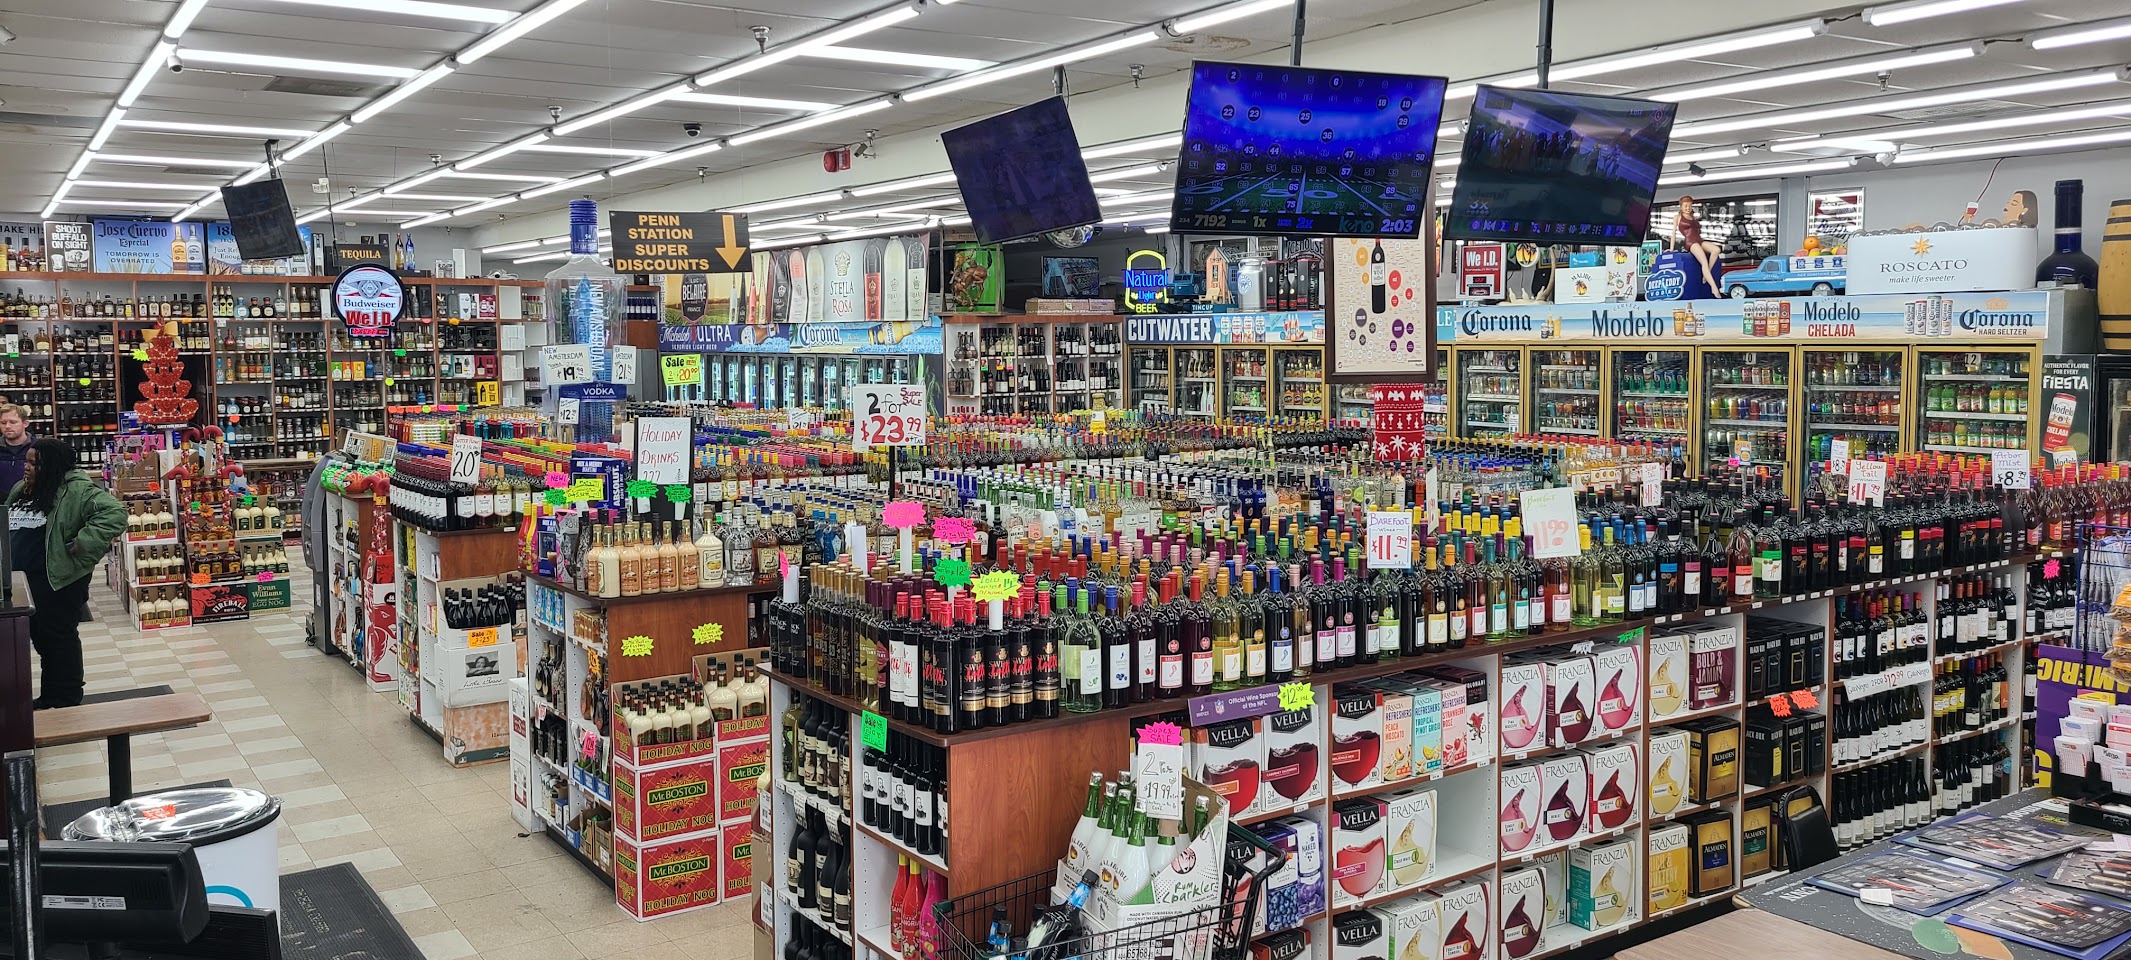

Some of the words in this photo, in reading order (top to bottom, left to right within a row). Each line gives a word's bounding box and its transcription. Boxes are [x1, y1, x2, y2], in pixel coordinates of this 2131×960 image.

[1223, 108, 1233, 116] 22
[1249, 110, 1259, 118] 23
[1300, 112, 1310, 120] 25
[1270, 147, 1279, 155] 44
[1344, 150, 1353, 158] 47
[1215, 162, 1226, 170] 52
[1341, 168, 1351, 176] 57
[1289, 183, 1299, 191] 65
[1286, 200, 1296, 208] 75
[638, 214, 680, 226] PENN
[1194, 215, 1227, 227] 7192
[1253, 216, 1267, 227] 1x
[1296, 217, 1313, 228] 2x
[1339, 216, 1374, 233] keno
[1381, 219, 1414, 233] 2:03
[55, 225, 82, 233] SHOOT
[98, 222, 126, 238] Jose
[127, 224, 168, 238] Cuervo
[628, 228, 693, 240] STATION
[51, 233, 87, 242] BUFFALO
[119, 238, 150, 247] Especial
[51, 241, 63, 249] ON
[64, 241, 89, 250] SIGHT
[635, 244, 688, 256] SUPER
[340, 250, 381, 259] TEQUILA
[1466, 251, 1481, 266] We
[1483, 251, 1498, 266] I.D.
[616, 258, 710, 271] DISCOUNTS
[1880, 259, 1968, 273] ROSCATO
[1125, 270, 1168, 288] Natural
[1571, 272, 1593, 282] MALIBU
[1666, 277, 1680, 287] EDDY
[1889, 276, 1909, 284] make
[1911, 274, 1923, 284] life
[1924, 274, 1956, 282] sweeter.
[682, 283, 707, 300] BELAIRE
[829, 280, 854, 295] STELLA
[1138, 290, 1156, 302] Light
[344, 299, 396, 308] Budweiser
[832, 299, 853, 315] ROSA
[1136, 303, 1158, 313] BEER
[1613, 303, 1640, 311] CERVEZA
[346, 311, 370, 326] We
[370, 312, 395, 326] I.D.
[1804, 301, 1860, 322] Modelo
[1461, 310, 1532, 339] Corona
[1592, 310, 1664, 337] Modelo
[1959, 309, 2034, 333] Corona
[660, 326, 689, 344] Michelob
[697, 324, 732, 342] ULTRA
[798, 324, 842, 347] Corona
[1128, 317, 1212, 341] CUTWATER
[1808, 323, 1855, 337] CHELADA
[666, 357, 685, 368] Sale
[1844, 353, 1857, 364] 11
[1964, 354, 1977, 366] 12
[582, 388, 615, 396] VODKA
[900, 387, 922, 399] Super
[866, 393, 880, 415] 2
[882, 393, 902, 414] for
[902, 397, 922, 406] SALE
[2052, 403, 2074, 416] Modelo
[640, 423, 682, 443] HOLIDAY
[861, 415, 922, 444] $23.99
[2047, 426, 2068, 436] CHELADA
[640, 450, 680, 468] DRINKS
[1855, 461, 1884, 470] Yellow
[1861, 470, 1877, 478] Tail
[1998, 471, 2027, 486] $8.99
[1369, 513, 1410, 526] BAREFOOT
[252, 590, 282, 598] Williams
[212, 600, 247, 614] FIREBALL
[1650, 641, 1683, 656] FRANZIA
[1698, 634, 1734, 650] FRANZIA
[1599, 652, 1634, 669] FRANZIA
[1696, 652, 1715, 669] BOLD
[1502, 668, 1540, 684] FRANZIA
[1558, 664, 1591, 680] FRANZIA
[1696, 666, 1723, 684] JAMMY
[1228, 696, 1246, 704] Official
[1246, 694, 1259, 702] Wine
[1259, 691, 1279, 701] Sponsor
[1442, 696, 1466, 709] REFRESHERS
[1340, 700, 1373, 714] VELLA
[1415, 703, 1440, 716] REFRESHERS
[1442, 707, 1466, 720] STRAWBERRY
[1274, 711, 1309, 727] VELLA
[1385, 708, 1412, 721] REFRESHERS
[1415, 717, 1434, 726] TROPICAL
[722, 718, 766, 734] HOLIDAY
[1385, 723, 1398, 732] PEACH
[1415, 725, 1428, 735] PINOT
[1150, 734, 1172, 743] SALE
[1212, 727, 1251, 742] VELLA
[1385, 731, 1405, 740] MOSCATO
[641, 744, 688, 760] HOLIDAY
[690, 739, 711, 754] NOG
[1652, 740, 1684, 754] FRANZIA
[1596, 752, 1633, 768] FRANZIA
[1713, 750, 1735, 762] ALMADEN
[1141, 752, 1159, 776] 2
[1545, 762, 1583, 778] FRANZIA
[1502, 772, 1537, 788] FRANZIA
[651, 792, 666, 803] Mr.
[665, 785, 705, 799] BOSTON
[1267, 790, 1275, 799] 34
[1391, 799, 1430, 819] FRANZIA
[643, 819, 689, 837] HOLIDAY
[692, 814, 714, 827] NOG
[1342, 812, 1377, 826] VELLA
[1744, 829, 1767, 840] ALMADEN
[1301, 844, 1317, 852] NAKED
[1650, 833, 1686, 852] FRANZIA
[1704, 843, 1726, 853] ALMADEN
[1593, 849, 1628, 866] FRANZIA
[653, 867, 666, 878] Mr.
[666, 860, 707, 875] BOSTON
[1174, 881, 1194, 894] Rum
[1502, 875, 1540, 895] FRANZIA
[644, 894, 690, 913] HOLIDAY
[694, 888, 715, 902] NOG
[1443, 891, 1483, 912] FRANZIA
[1398, 908, 1436, 930] FRANZIA
[1340, 926, 1378, 941] VELLA
[1272, 940, 1303, 960] VELLA
